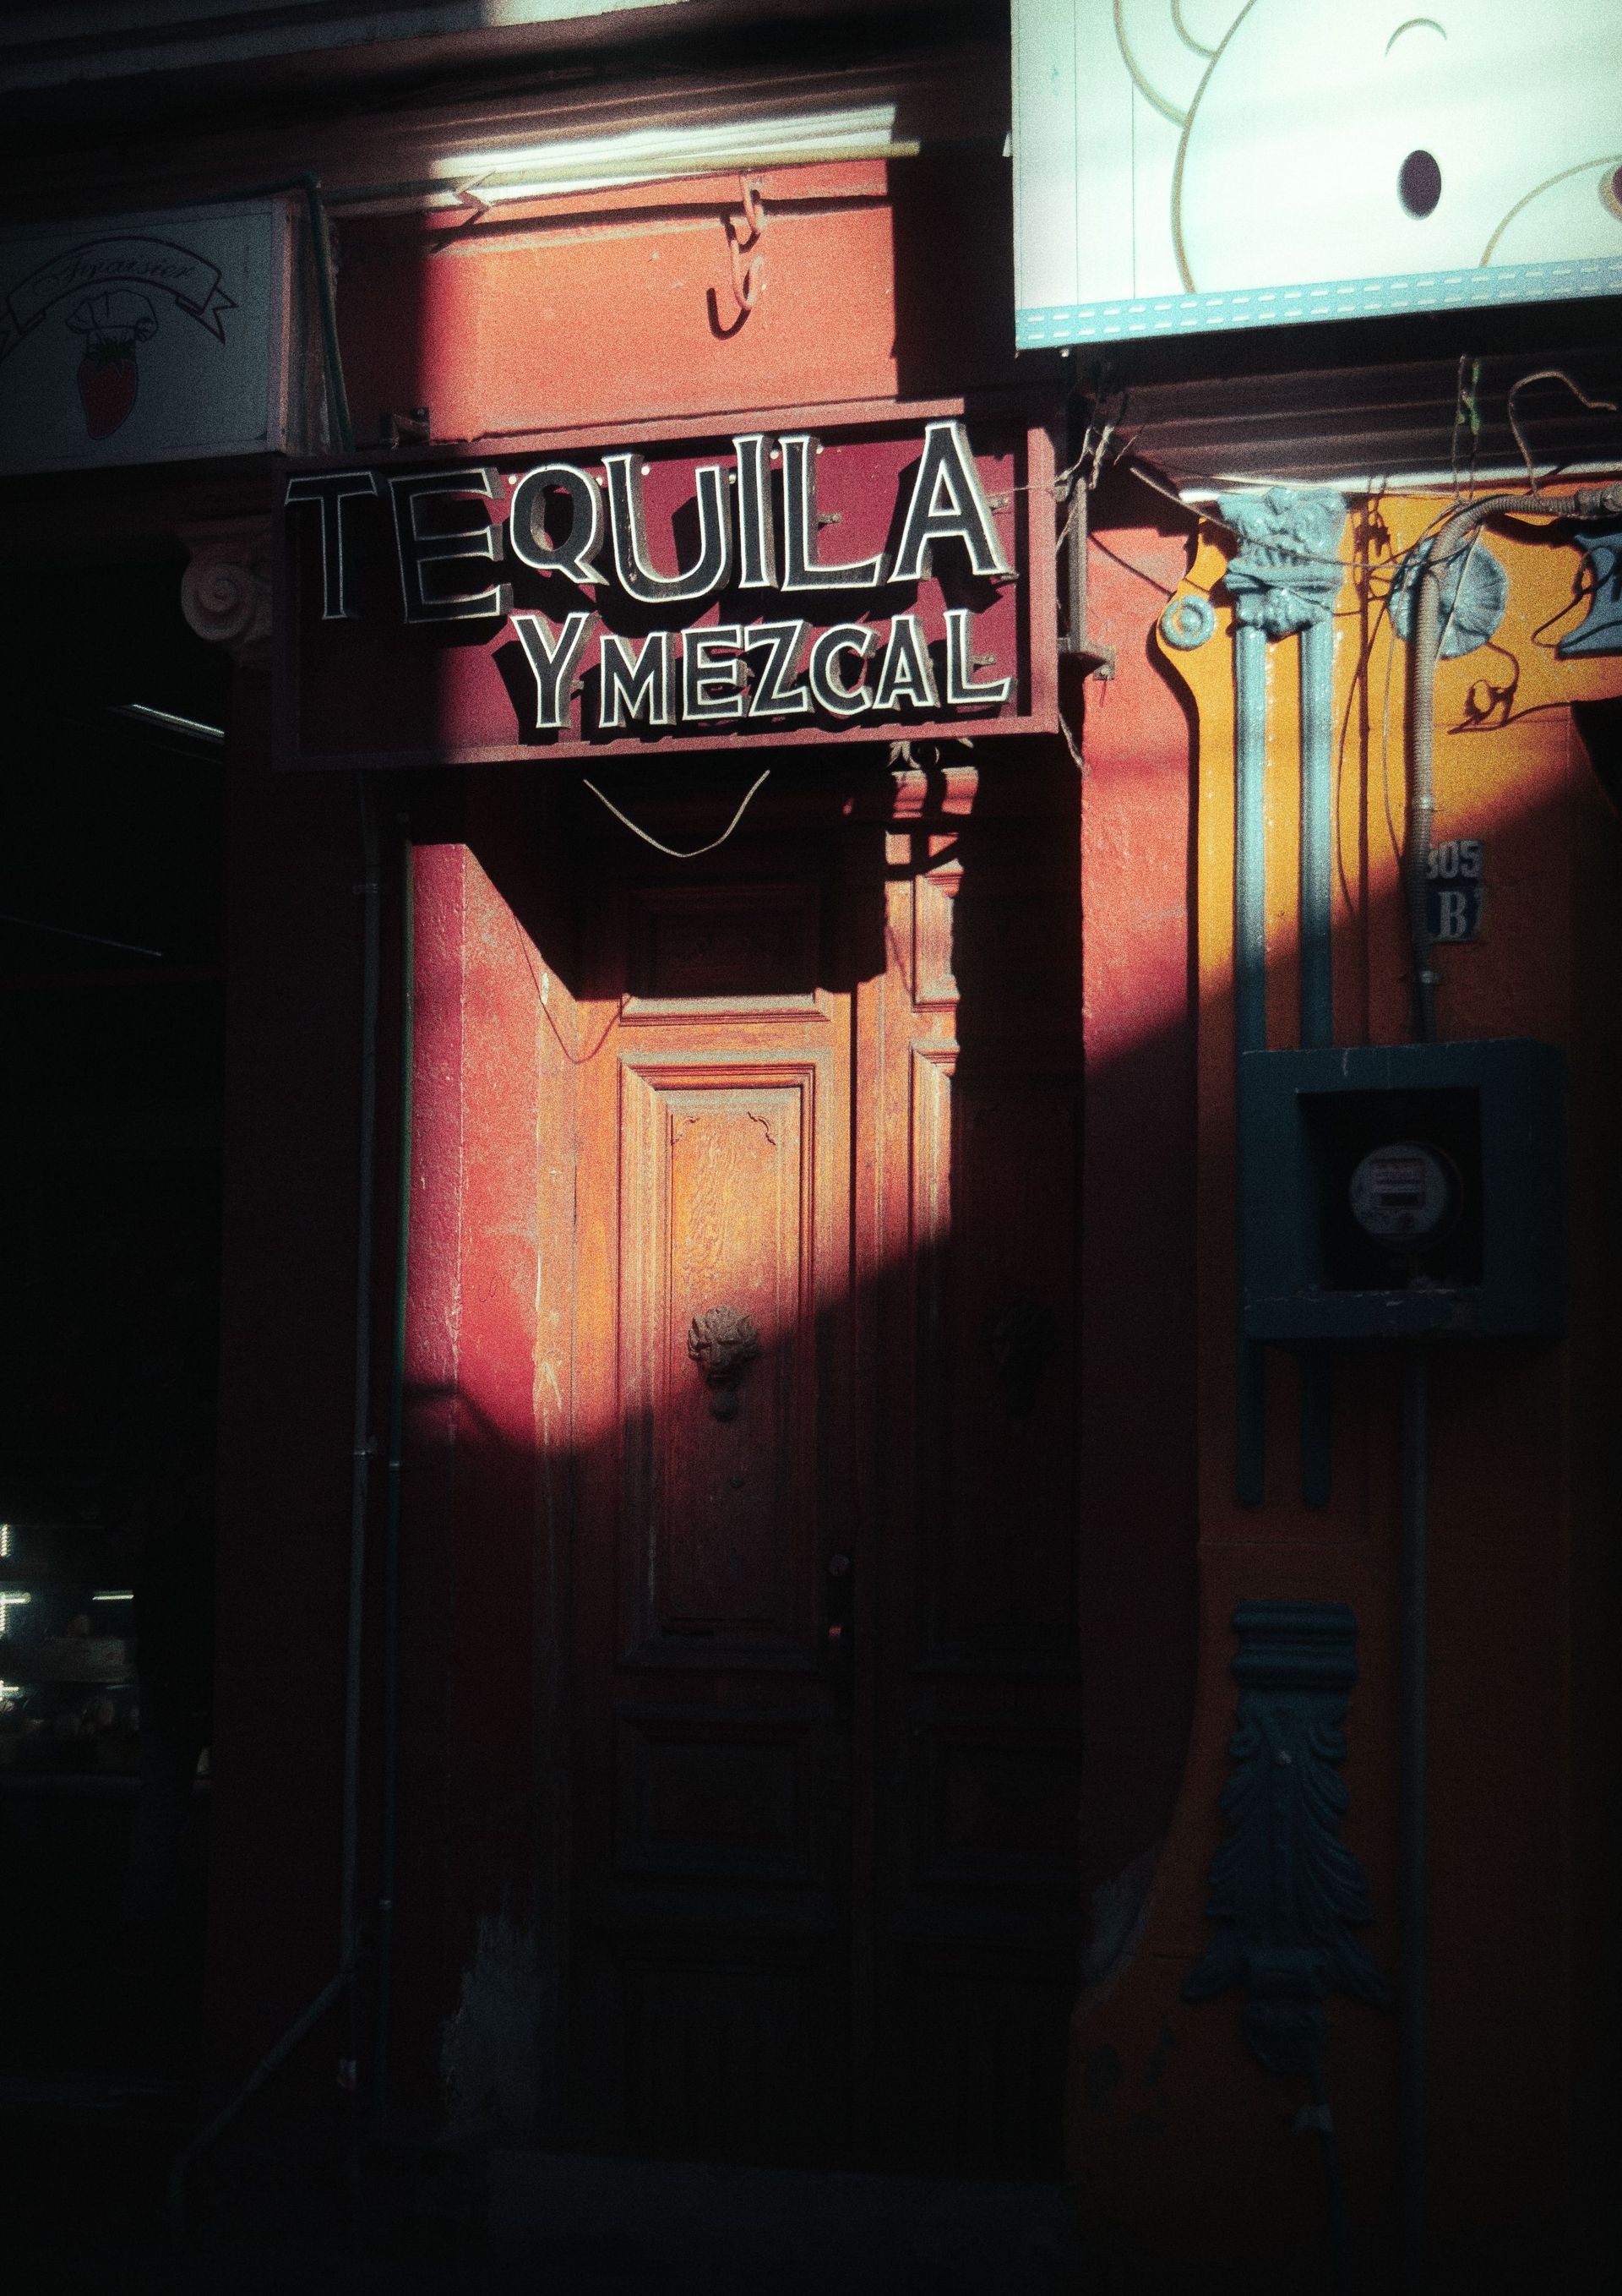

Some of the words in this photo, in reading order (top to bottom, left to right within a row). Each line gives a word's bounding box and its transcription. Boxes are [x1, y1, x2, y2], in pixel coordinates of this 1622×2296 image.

[286, 419, 1018, 624] TEQUILA
[598, 608, 1011, 728] MEZCAL
[1437, 890, 1468, 939] B
